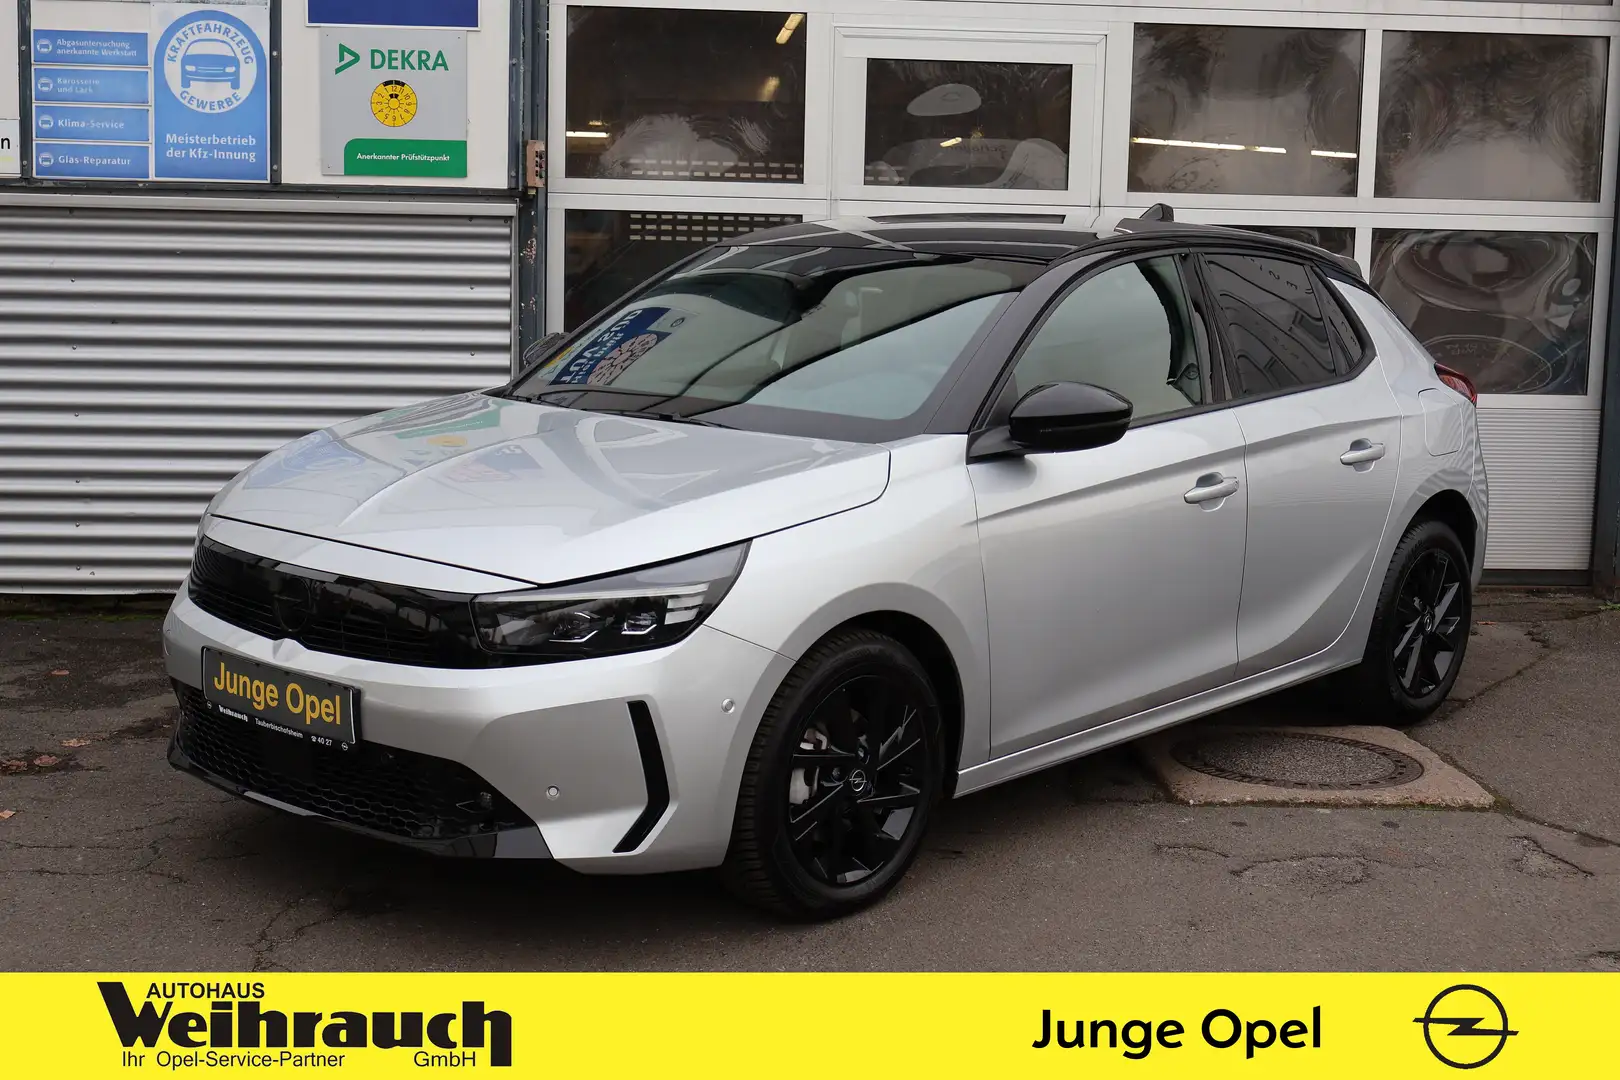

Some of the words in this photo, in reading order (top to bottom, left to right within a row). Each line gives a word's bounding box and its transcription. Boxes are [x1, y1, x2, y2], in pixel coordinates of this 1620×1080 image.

[56, 39, 130, 49] Abgasuntersuchung
[167, 23, 254, 65] KRAFTFAHRZEUG
[56, 48, 99, 56] anerkannte
[101, 49, 137, 57] Werkstatt
[370, 49, 449, 71] DEKRA
[179, 90, 241, 111] GEWERBE
[58, 119, 125, 129] Klima-Service
[166, 133, 256, 146] Meisterbetrieb
[58, 155, 131, 167] Glas-Reparatur
[166, 147, 186, 158] der
[189, 148, 256, 163] Kfz-Innung
[401, 153, 450, 163] Prüfstützpunkt
[213, 661, 279, 711] Junge
[285, 682, 341, 725] Opel
